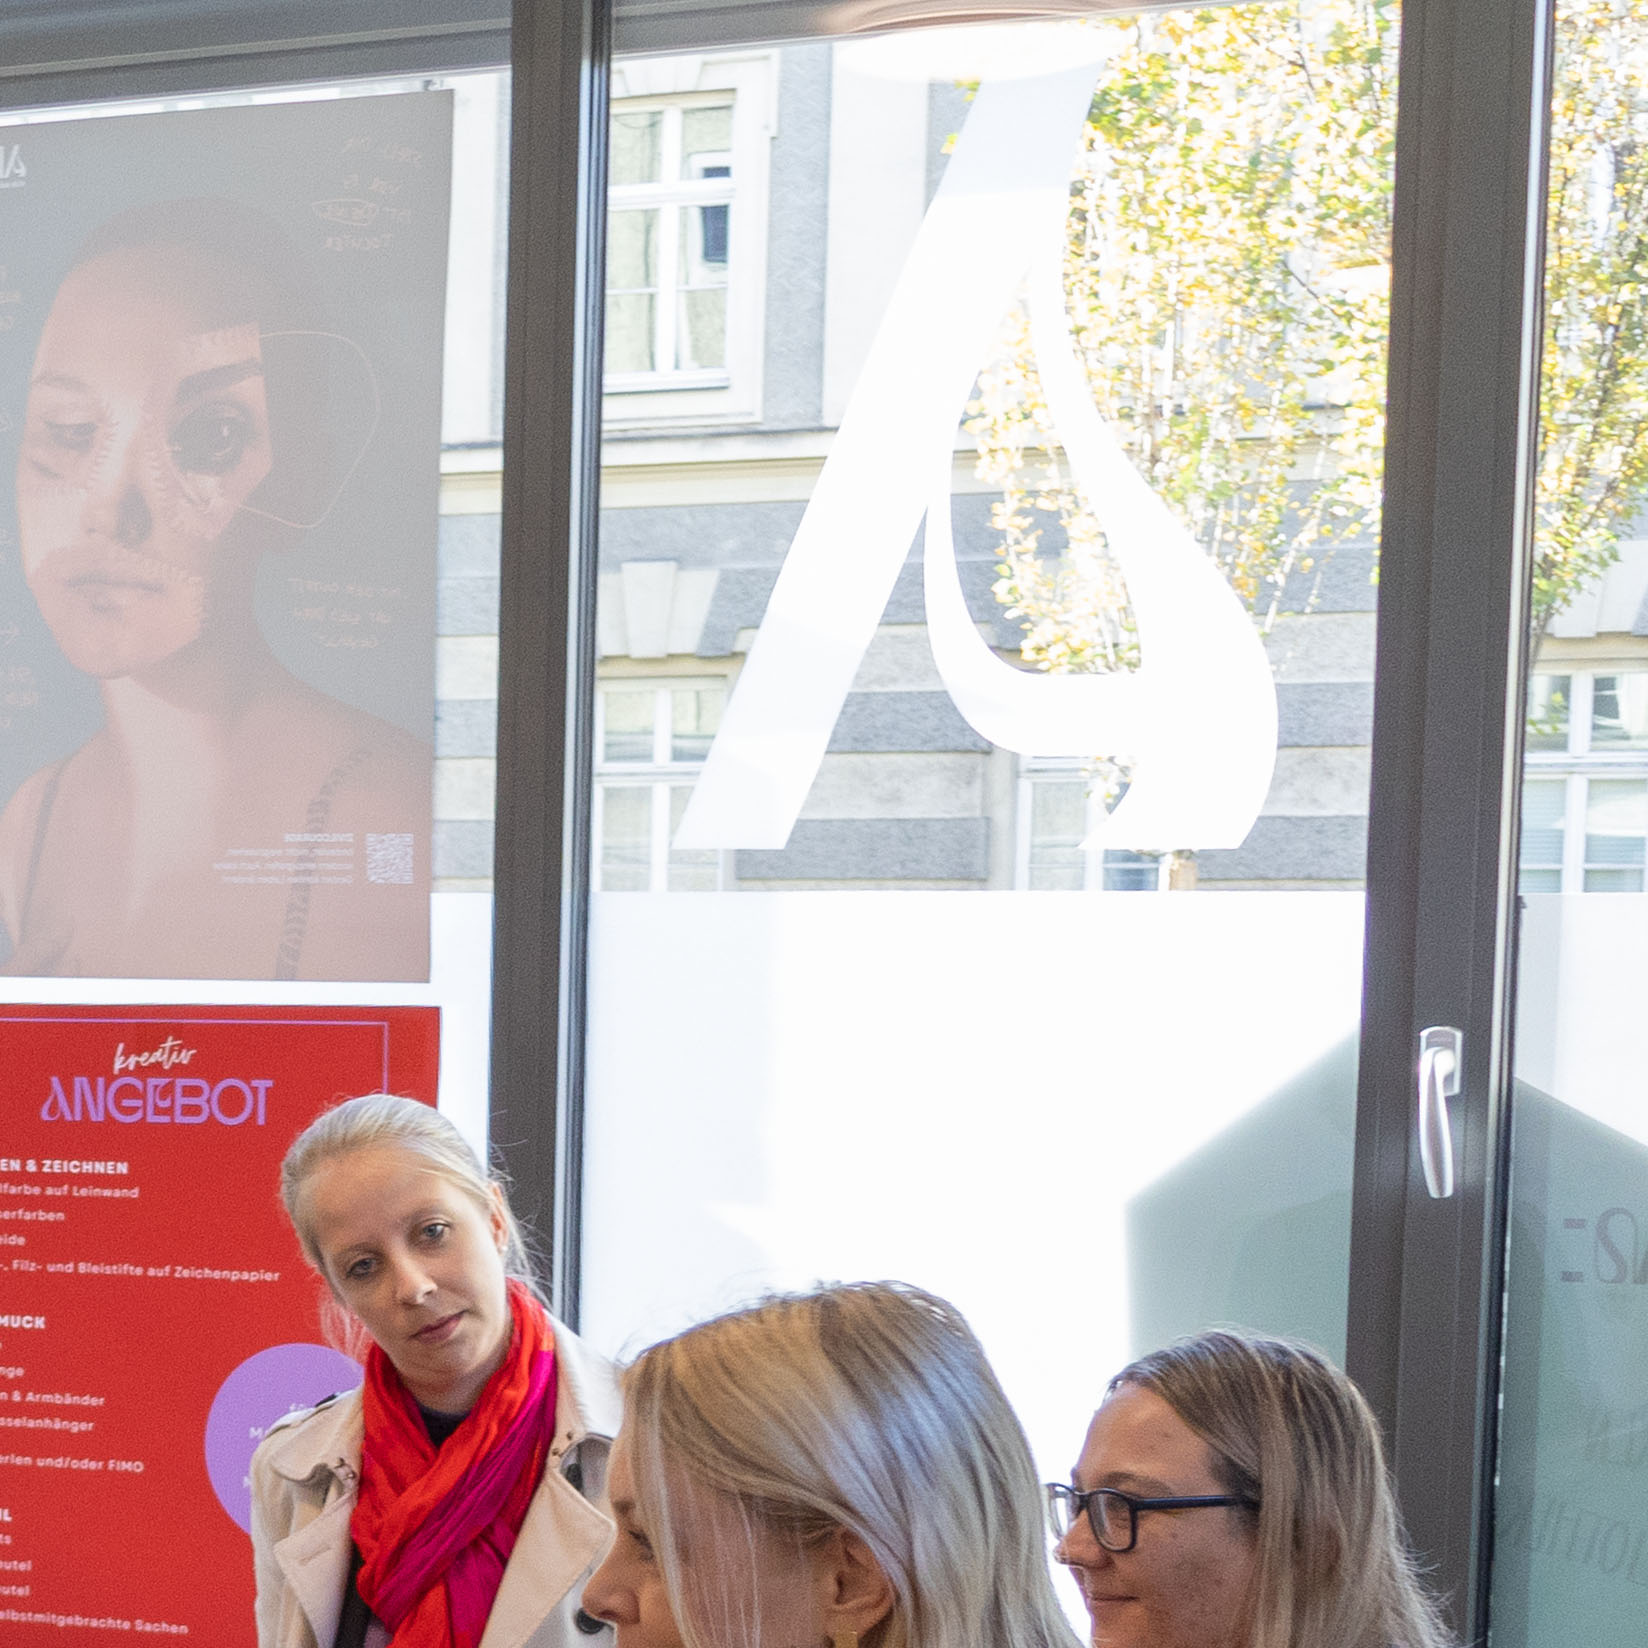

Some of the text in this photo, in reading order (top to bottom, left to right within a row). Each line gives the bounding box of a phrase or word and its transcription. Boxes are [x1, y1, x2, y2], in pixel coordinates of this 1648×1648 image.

[113, 1036, 196, 1074] kreativ
[41, 1076, 273, 1125] ANGEBOT
[26, 1160, 37, 1172] &
[42, 1160, 128, 1174] ZEICHNEN
[45, 1184, 69, 1196] auf
[72, 1186, 139, 1198] Leinwand
[12, 1259, 42, 1271] Filz-
[46, 1262, 74, 1273] und
[77, 1262, 144, 1276] Bleistifte
[147, 1265, 170, 1277] auf
[174, 1266, 280, 1282] Zeichenpapier
[12, 1391, 21, 1402] &
[25, 1392, 104, 1406] Armbänder
[36, 1457, 103, 1470] und/oder
[108, 1460, 144, 1473] FIMO
[134, 1619, 188, 1634] Sachen
